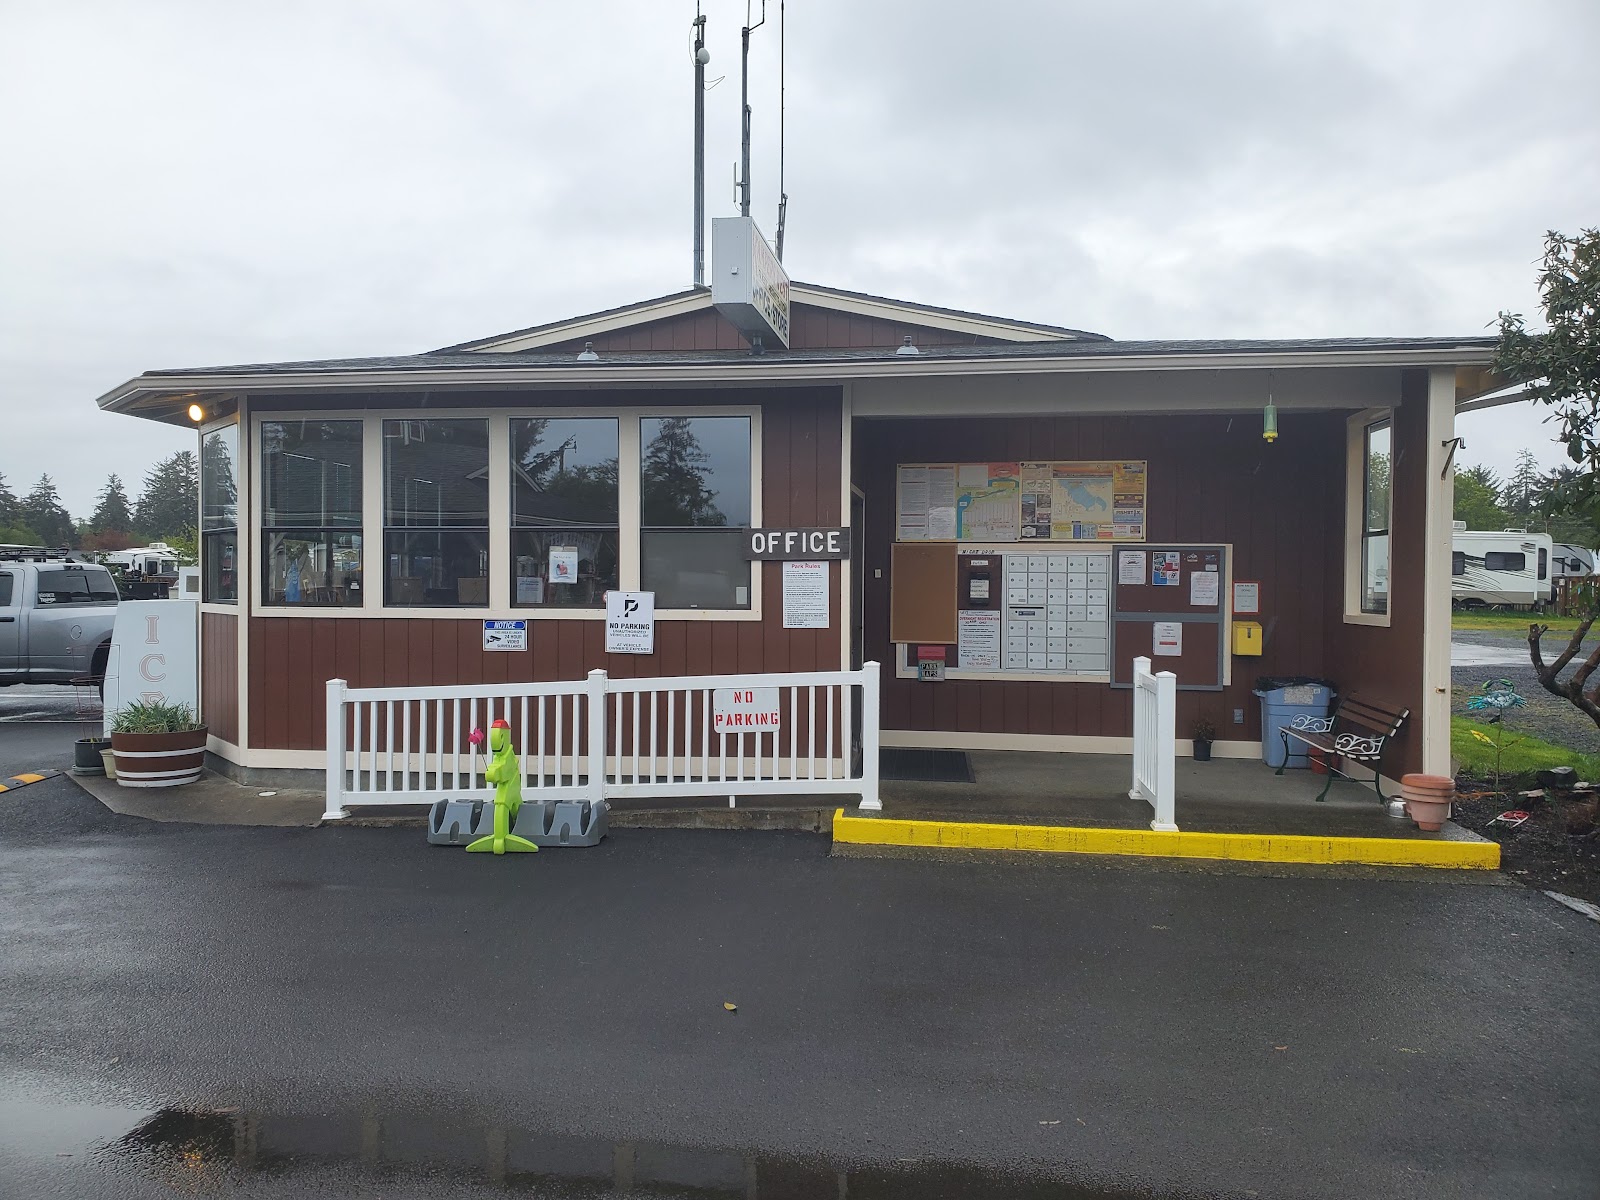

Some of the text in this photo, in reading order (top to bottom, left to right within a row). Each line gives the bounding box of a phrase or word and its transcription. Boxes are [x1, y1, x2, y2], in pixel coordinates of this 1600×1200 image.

[751, 532, 840, 553] OFFICE
[493, 621, 516, 629] NOTICE
[734, 691, 753, 704] NO
[715, 712, 779, 727] PARKING
